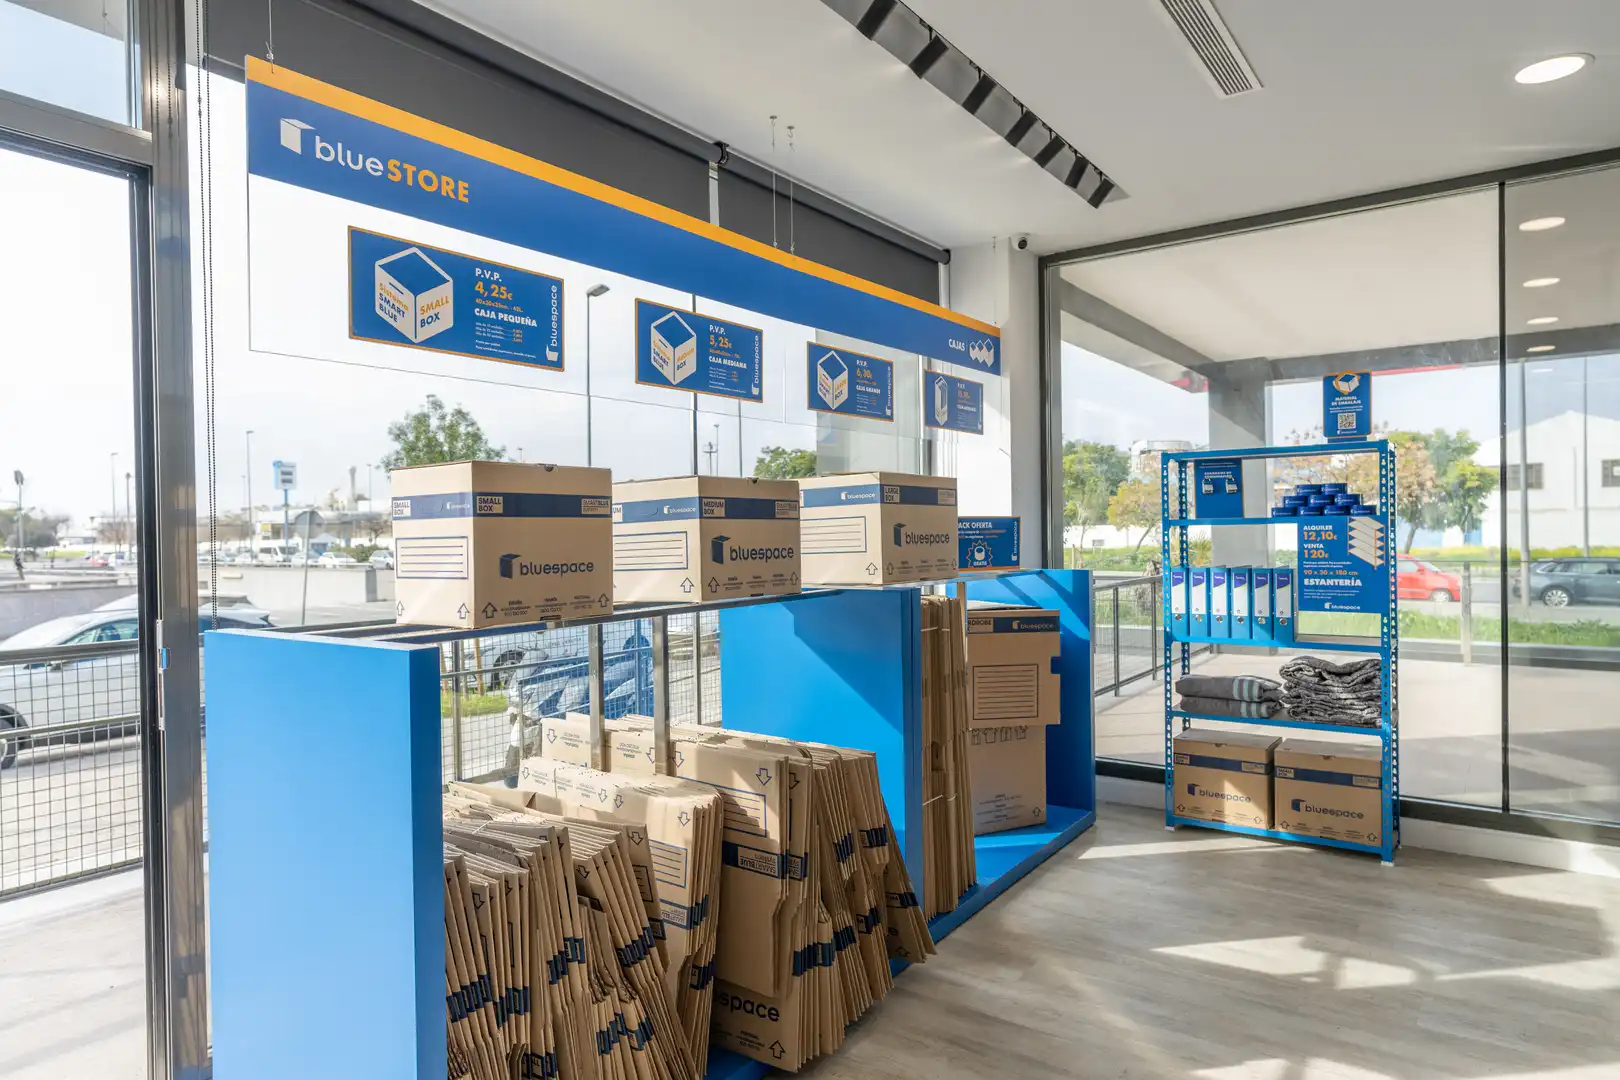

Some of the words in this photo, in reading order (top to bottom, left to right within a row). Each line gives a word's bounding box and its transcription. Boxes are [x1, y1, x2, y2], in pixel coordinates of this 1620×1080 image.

[475, 267, 502, 282] P.V.P.
[379, 292, 405, 318] SMART
[379, 303, 398, 323] BLUE
[420, 295, 450, 315] SMALL
[420, 311, 441, 329] BOX
[474, 307, 497, 320] CAJA
[498, 312, 538, 327] PEQUEÑA
[550, 284, 559, 347] bluespace
[709, 324, 726, 335] P.V.P.
[948, 338, 966, 352] CAJAS
[708, 356, 723, 367] CAJA
[724, 358, 748, 370] MEDIANA
[478, 497, 502, 505] SMALL
[478, 504, 494, 512] BOX
[905, 532, 950, 548] bluespace
[1303, 531, 1337, 541] 12,10€
[729, 545, 795, 564] bluespace
[1303, 549, 1329, 559] 120€
[520, 560, 595, 579] bluespace
[1303, 576, 1363, 587] ESTANTERÍA
[1199, 789, 1252, 803] bluespace
[1305, 804, 1365, 820] bluespace
[720, 992, 780, 1023] space
